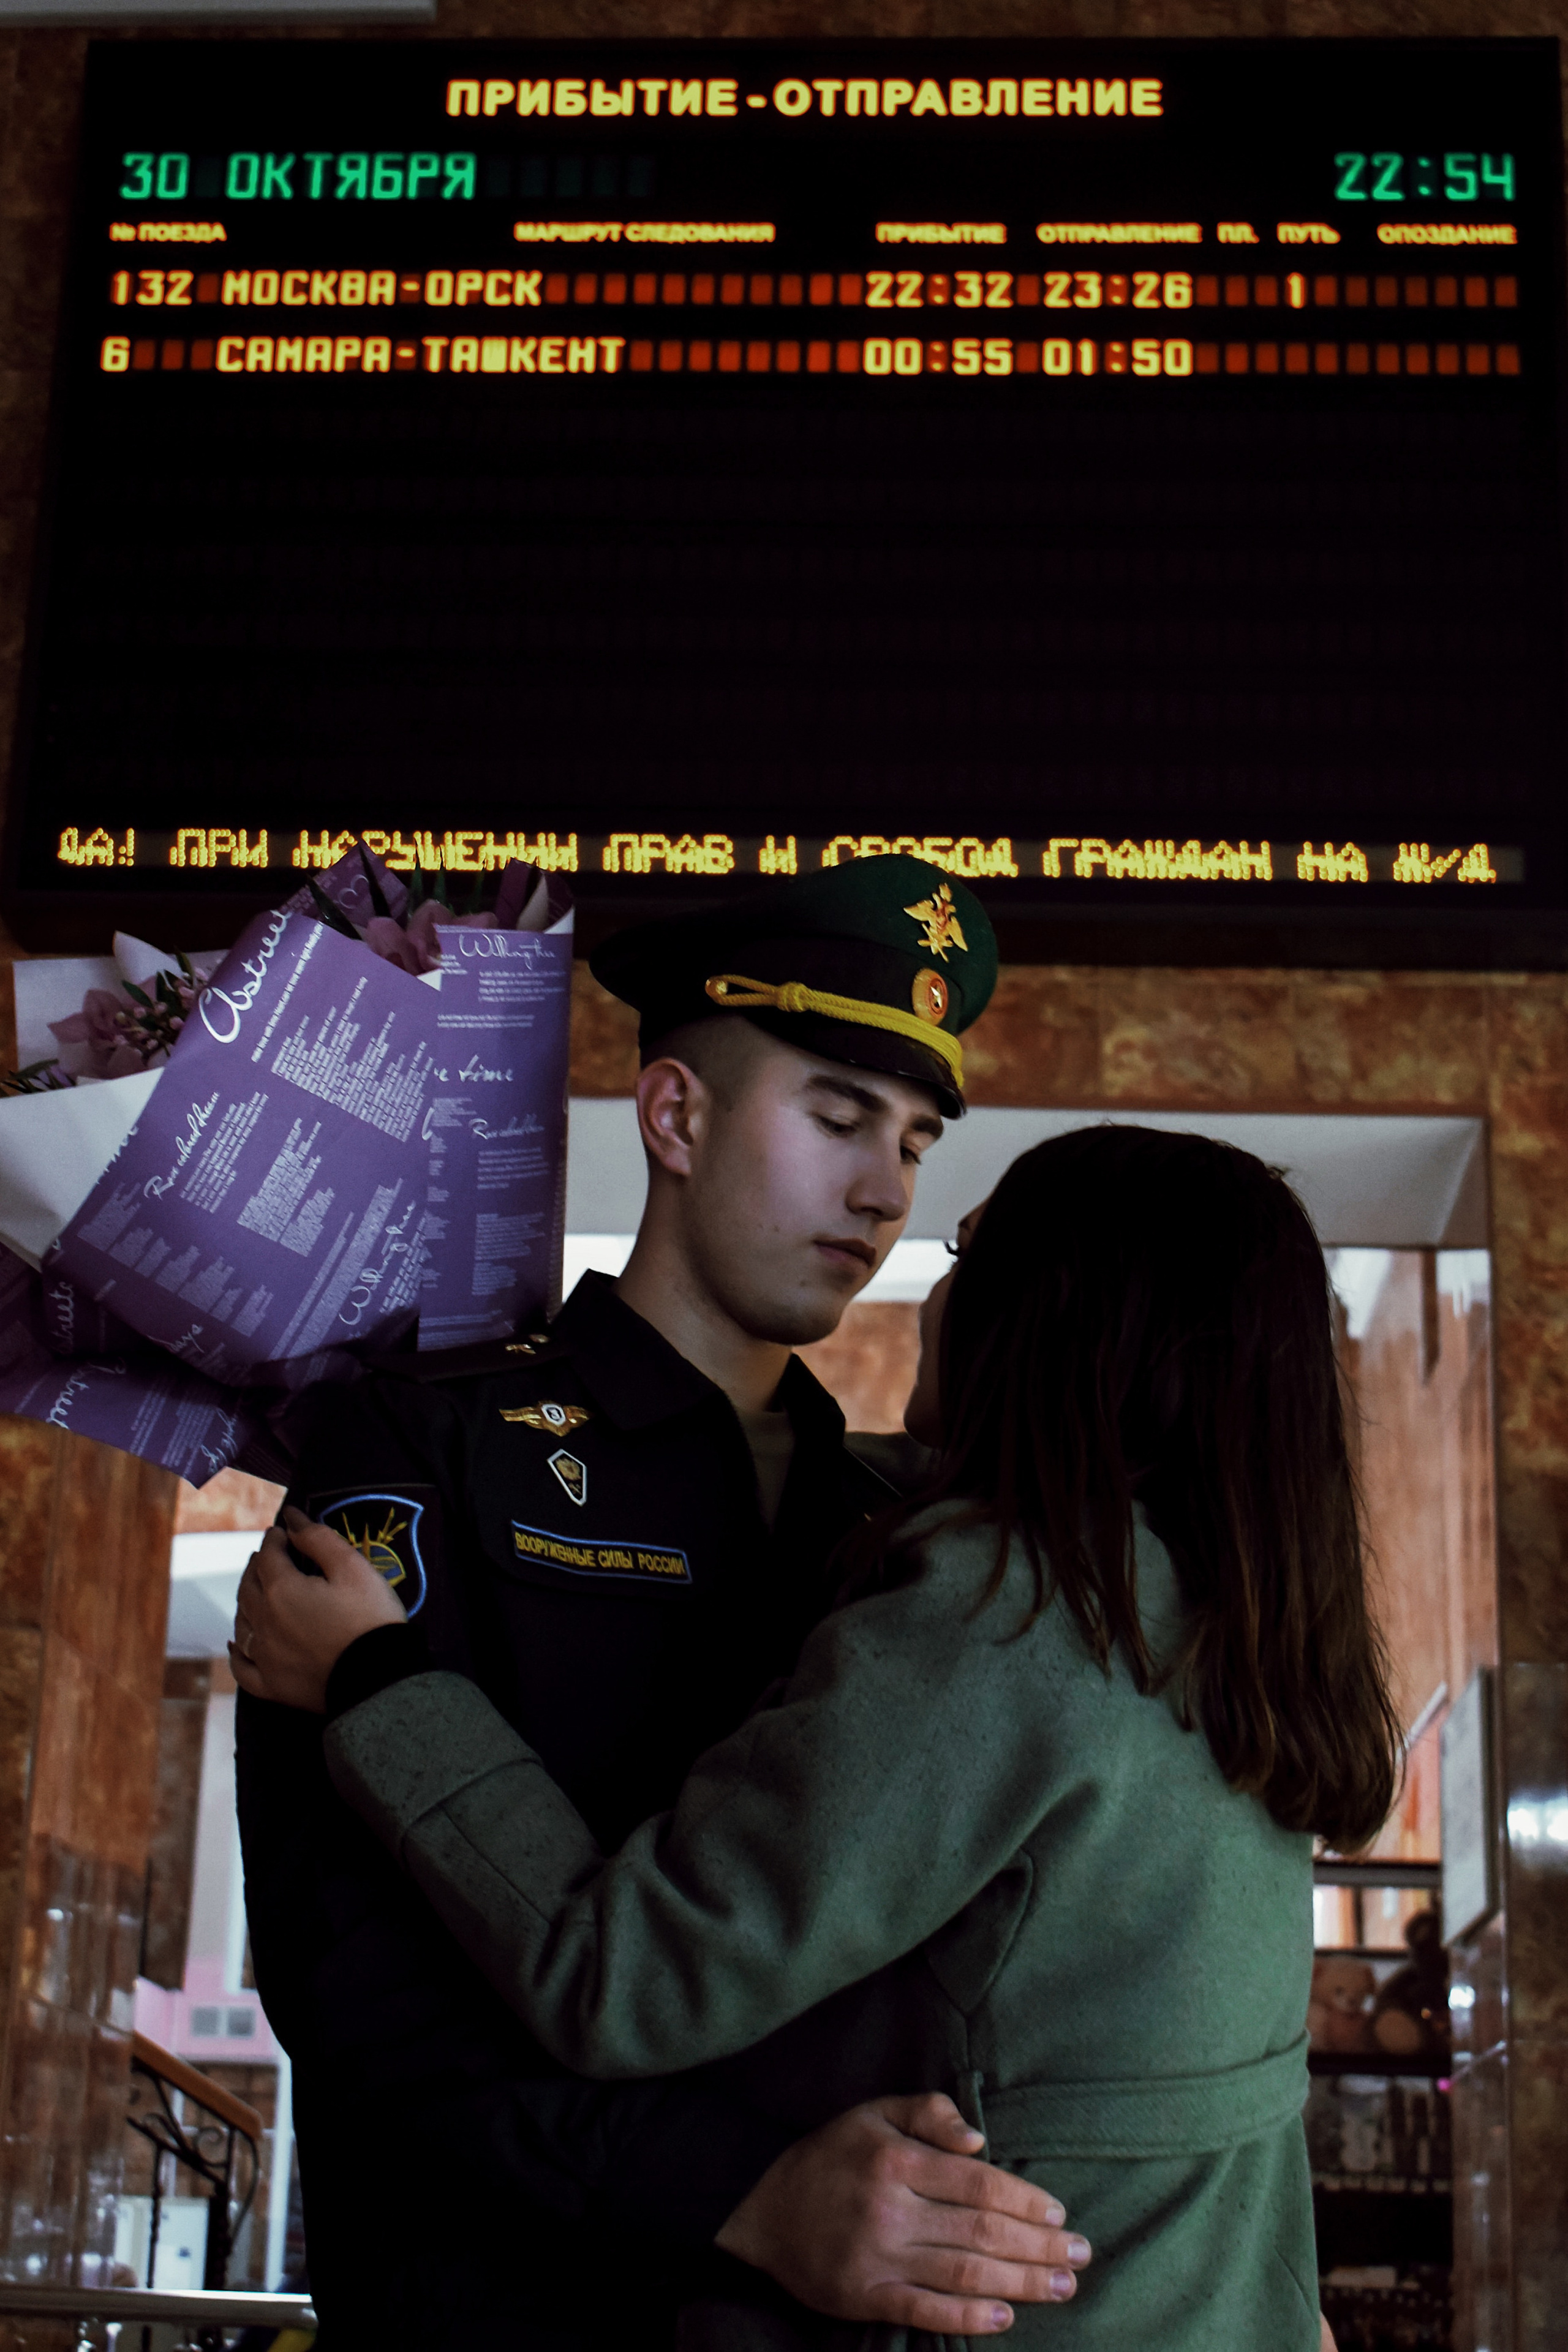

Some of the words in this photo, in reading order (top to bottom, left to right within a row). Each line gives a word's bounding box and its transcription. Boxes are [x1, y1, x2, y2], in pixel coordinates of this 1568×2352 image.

[121, 153, 189, 200] 30
[226, 153, 476, 200] ОКТЯБРЯ
[1335, 153, 1515, 201] 22:54
[138, 223, 227, 243] ПОЕЗДА
[514, 223, 623, 242] МАРШРУТ
[625, 224, 775, 243] СЛЕДОВАНИЯ
[876, 223, 1006, 244] ПРИБЫТИЕ
[1036, 224, 1202, 244] ОТПРАВЛЕНИЕ
[1277, 223, 1340, 243] ПУТЬ
[1378, 224, 1517, 245] ОПОЗДАНИЕ
[114, 271, 192, 305] 132
[222, 271, 541, 306] МОСКВА-ОРСК
[865, 273, 1012, 308] 22:32
[1044, 273, 1192, 308] 23:26
[1287, 273, 1304, 308] 1
[102, 337, 129, 372] 6
[217, 337, 625, 373] САМАРА-ТАШКЕНТ
[864, 339, 1012, 375] 00:55
[1043, 340, 1192, 375] 01:50
[170, 828, 268, 867] ПРИ
[603, 834, 735, 873] ПРАВ
[759, 835, 797, 875] И
[1042, 839, 1273, 881] ГРАЖДАН
[1297, 841, 1368, 883] НА
[1393, 843, 1496, 883] Ж/Д
[514, 1531, 597, 1567] ВООРУЖЕННЫЕ
[598, 1548, 635, 1569] СИЛЫ
[637, 1551, 686, 1575] РОССИИ
